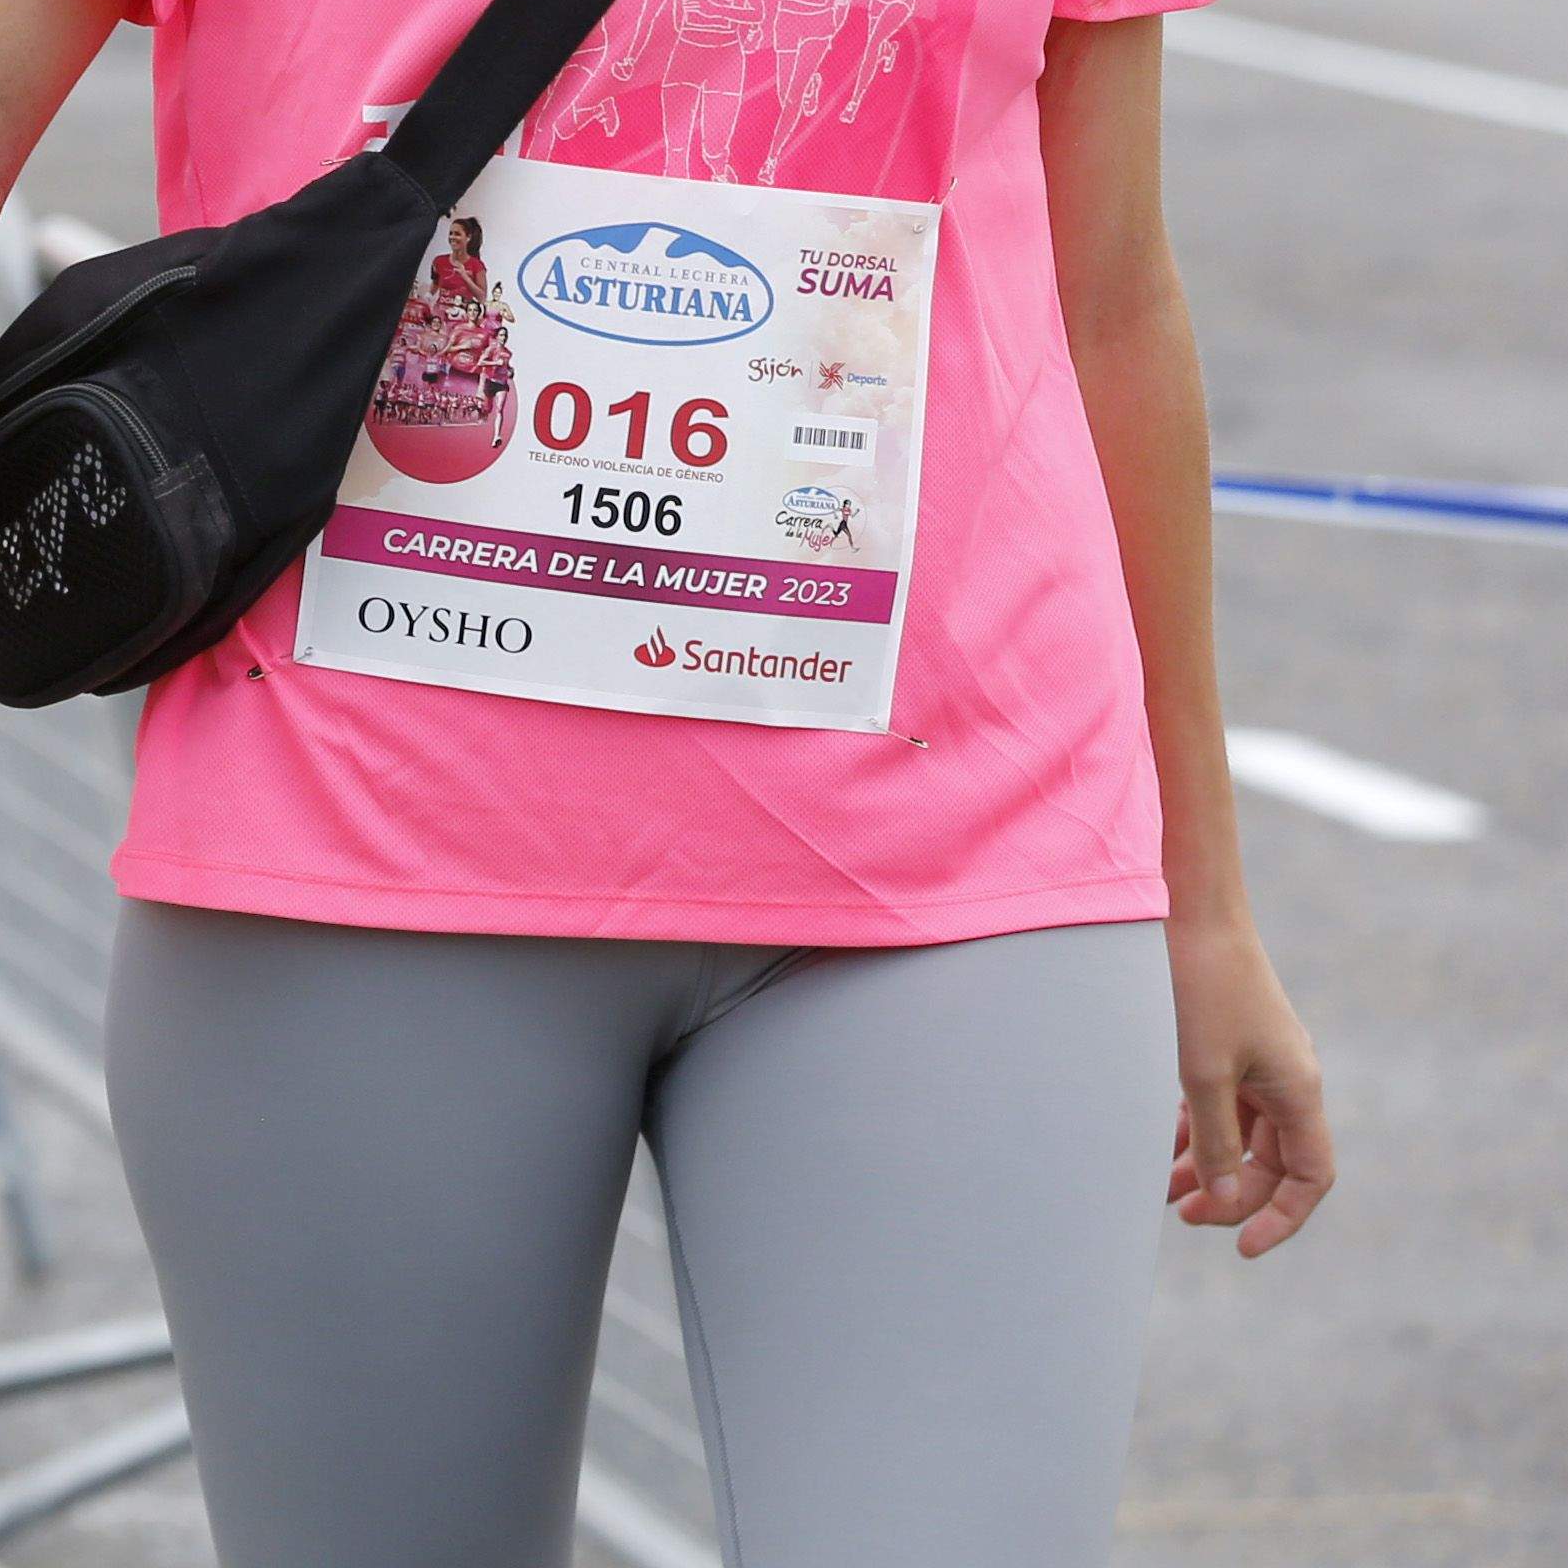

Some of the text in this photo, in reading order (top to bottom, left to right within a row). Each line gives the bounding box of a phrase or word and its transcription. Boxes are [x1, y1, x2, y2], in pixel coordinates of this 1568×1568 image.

[580, 256, 750, 287] CENTRAL LECHERA
[799, 249, 897, 273] TU DORSAL
[536, 258, 753, 323] ASTURIANA
[797, 267, 895, 301] SUMA
[847, 371, 887, 387] Deporte
[533, 381, 728, 466] 016
[528, 451, 724, 484] TELÉFONO VIOLENCIA DE GÉNERO
[563, 483, 683, 536] 1506
[775, 511, 822, 528] Carrera
[383, 528, 851, 606] CARRERA DE LA MUJER 2023
[358, 597, 533, 654] OYSHO
[683, 639, 852, 684] Santander
